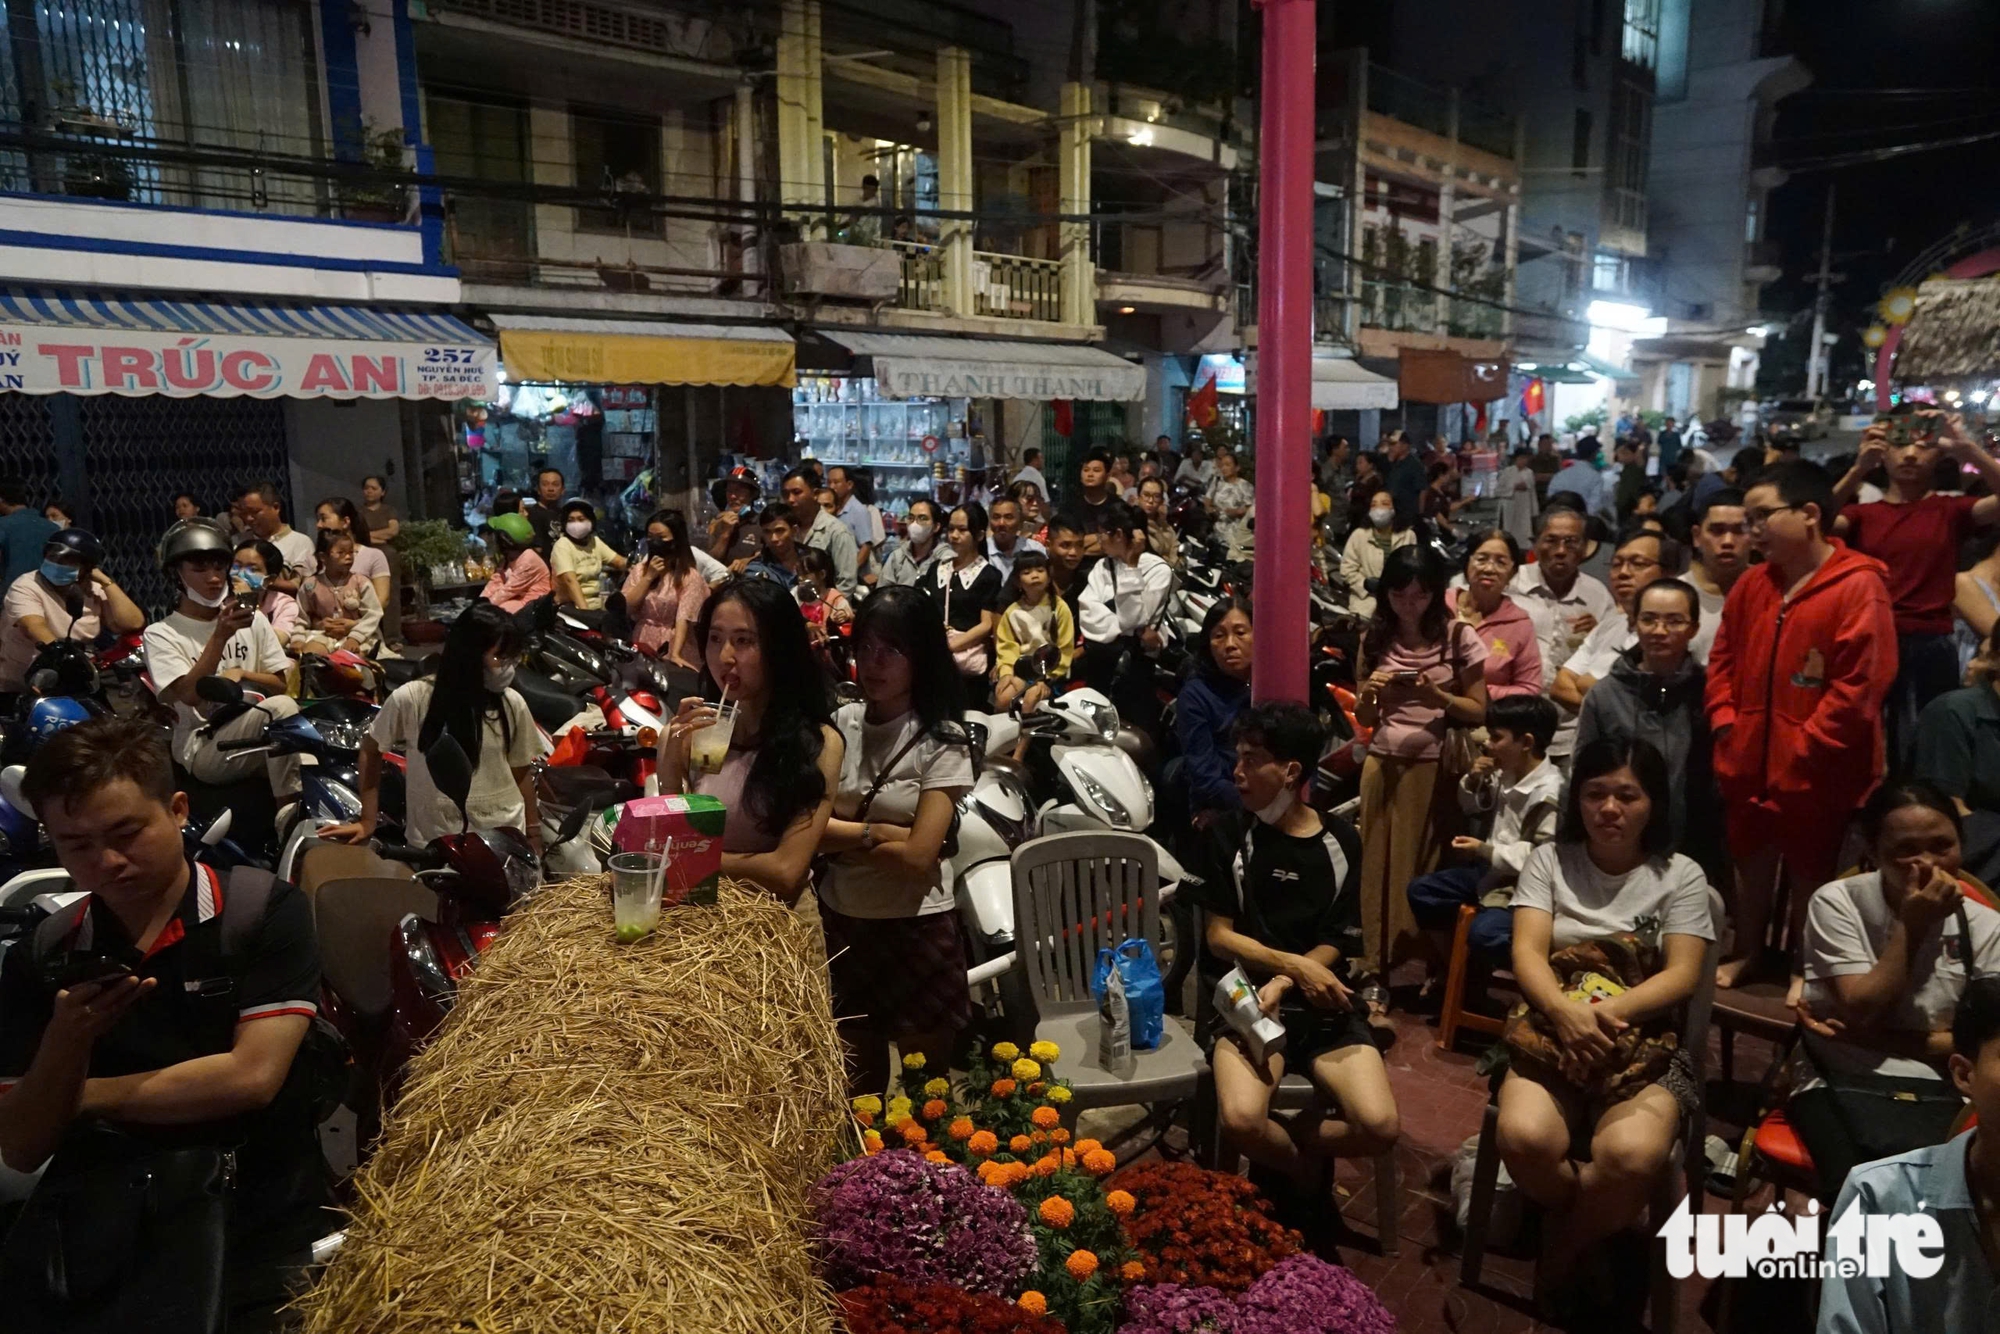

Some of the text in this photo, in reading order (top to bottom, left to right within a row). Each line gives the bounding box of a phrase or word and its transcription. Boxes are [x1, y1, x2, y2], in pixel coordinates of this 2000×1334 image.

[38, 338, 402, 392] TRÚC AN
[424, 347, 476, 364] 257
[898, 372, 1103, 397] THANH THANH
